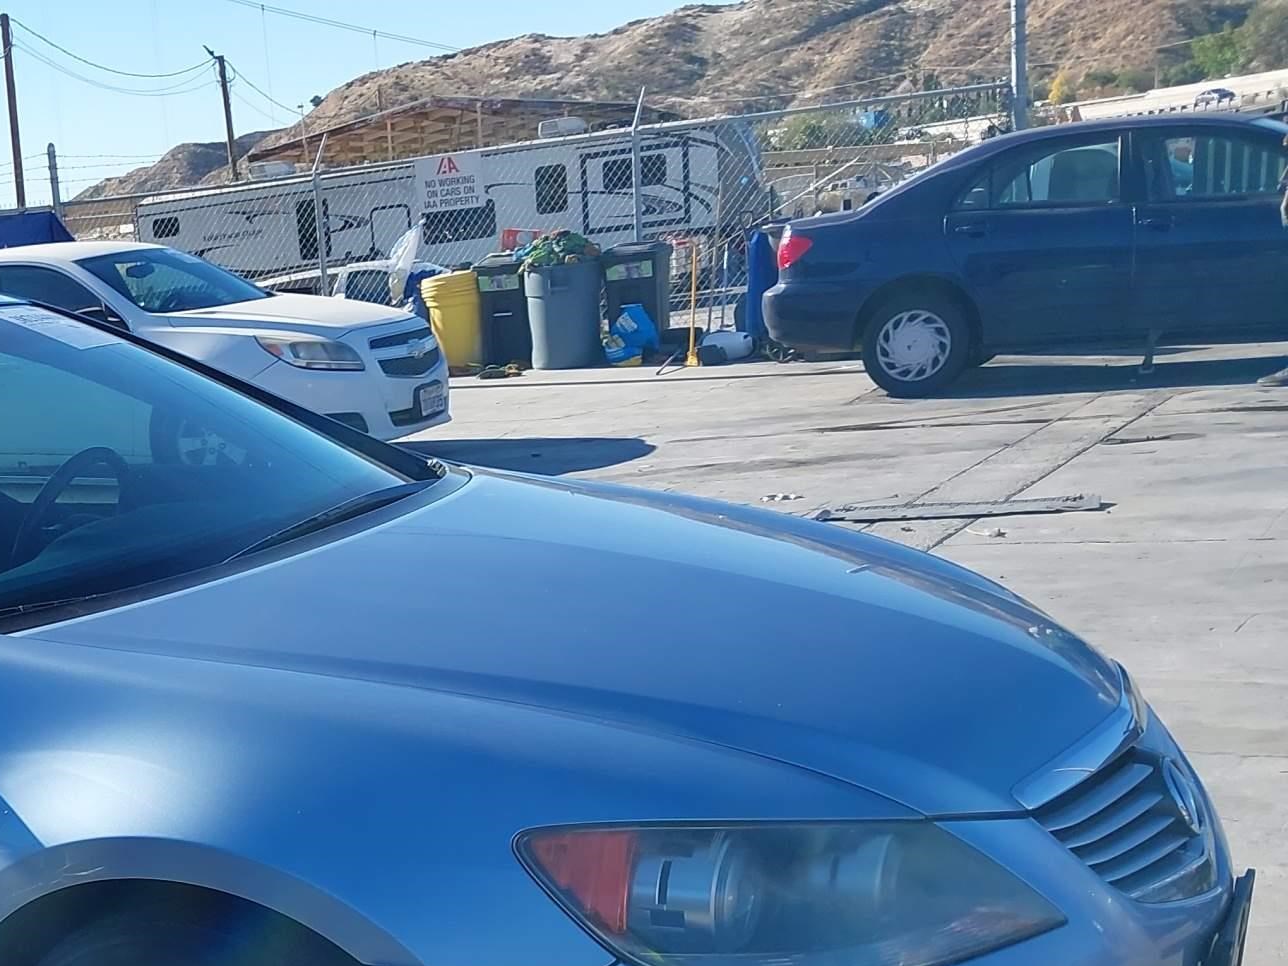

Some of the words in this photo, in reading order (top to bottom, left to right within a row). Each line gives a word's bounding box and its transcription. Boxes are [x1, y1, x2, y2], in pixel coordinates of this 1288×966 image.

[424, 179, 436, 189] NO
[438, 175, 475, 188] WORKING
[427, 190, 438, 199] ON
[439, 186, 461, 198] CARS
[463, 184, 475, 195] ON
[424, 199, 438, 210] IAA
[439, 195, 479, 208] PROPERTY
